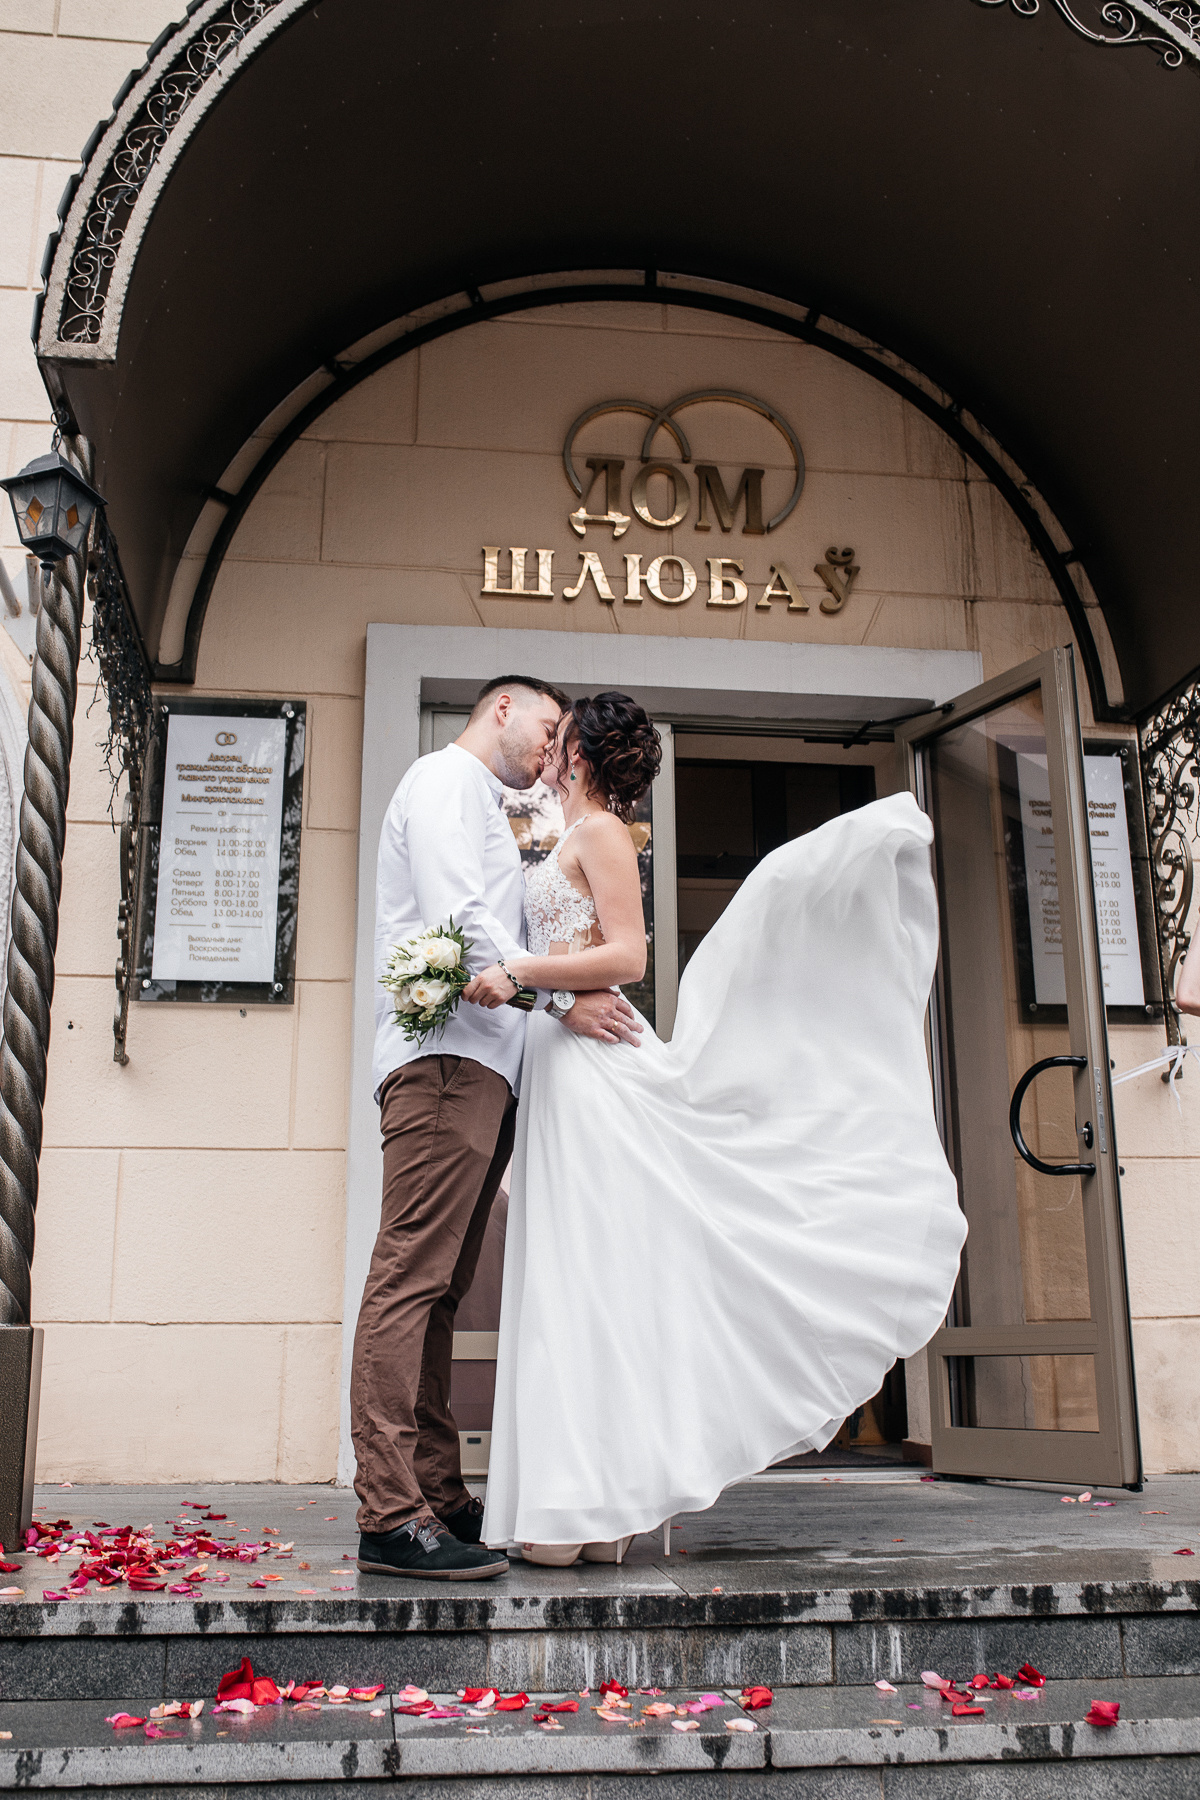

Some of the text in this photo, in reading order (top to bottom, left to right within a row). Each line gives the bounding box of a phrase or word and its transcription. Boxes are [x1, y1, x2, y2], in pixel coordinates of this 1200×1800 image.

[568, 457, 765, 540] ДОМ
[480, 546, 860, 614] ШЛЮБАЎ
[207, 752, 242, 763] Дворец
[176, 763, 273, 774] гражданских обрядов
[178, 774, 270, 784] главного управления
[204, 785, 242, 793] юстиции
[181, 793, 264, 805] Мингорисполкома
[190, 824, 218, 832] Режим
[174, 838, 207, 846] Вторник
[174, 847, 197, 856] Обед
[172, 868, 201, 877] Среда
[172, 878, 204, 888] Четверг
[171, 888, 205, 897] Пятница
[170, 898, 208, 907] Суббота
[170, 907, 193, 917] Обед
[187, 935, 225, 943] Выходные
[188, 944, 241, 953] Воскресенье
[188, 953, 240, 962] Понедельник
